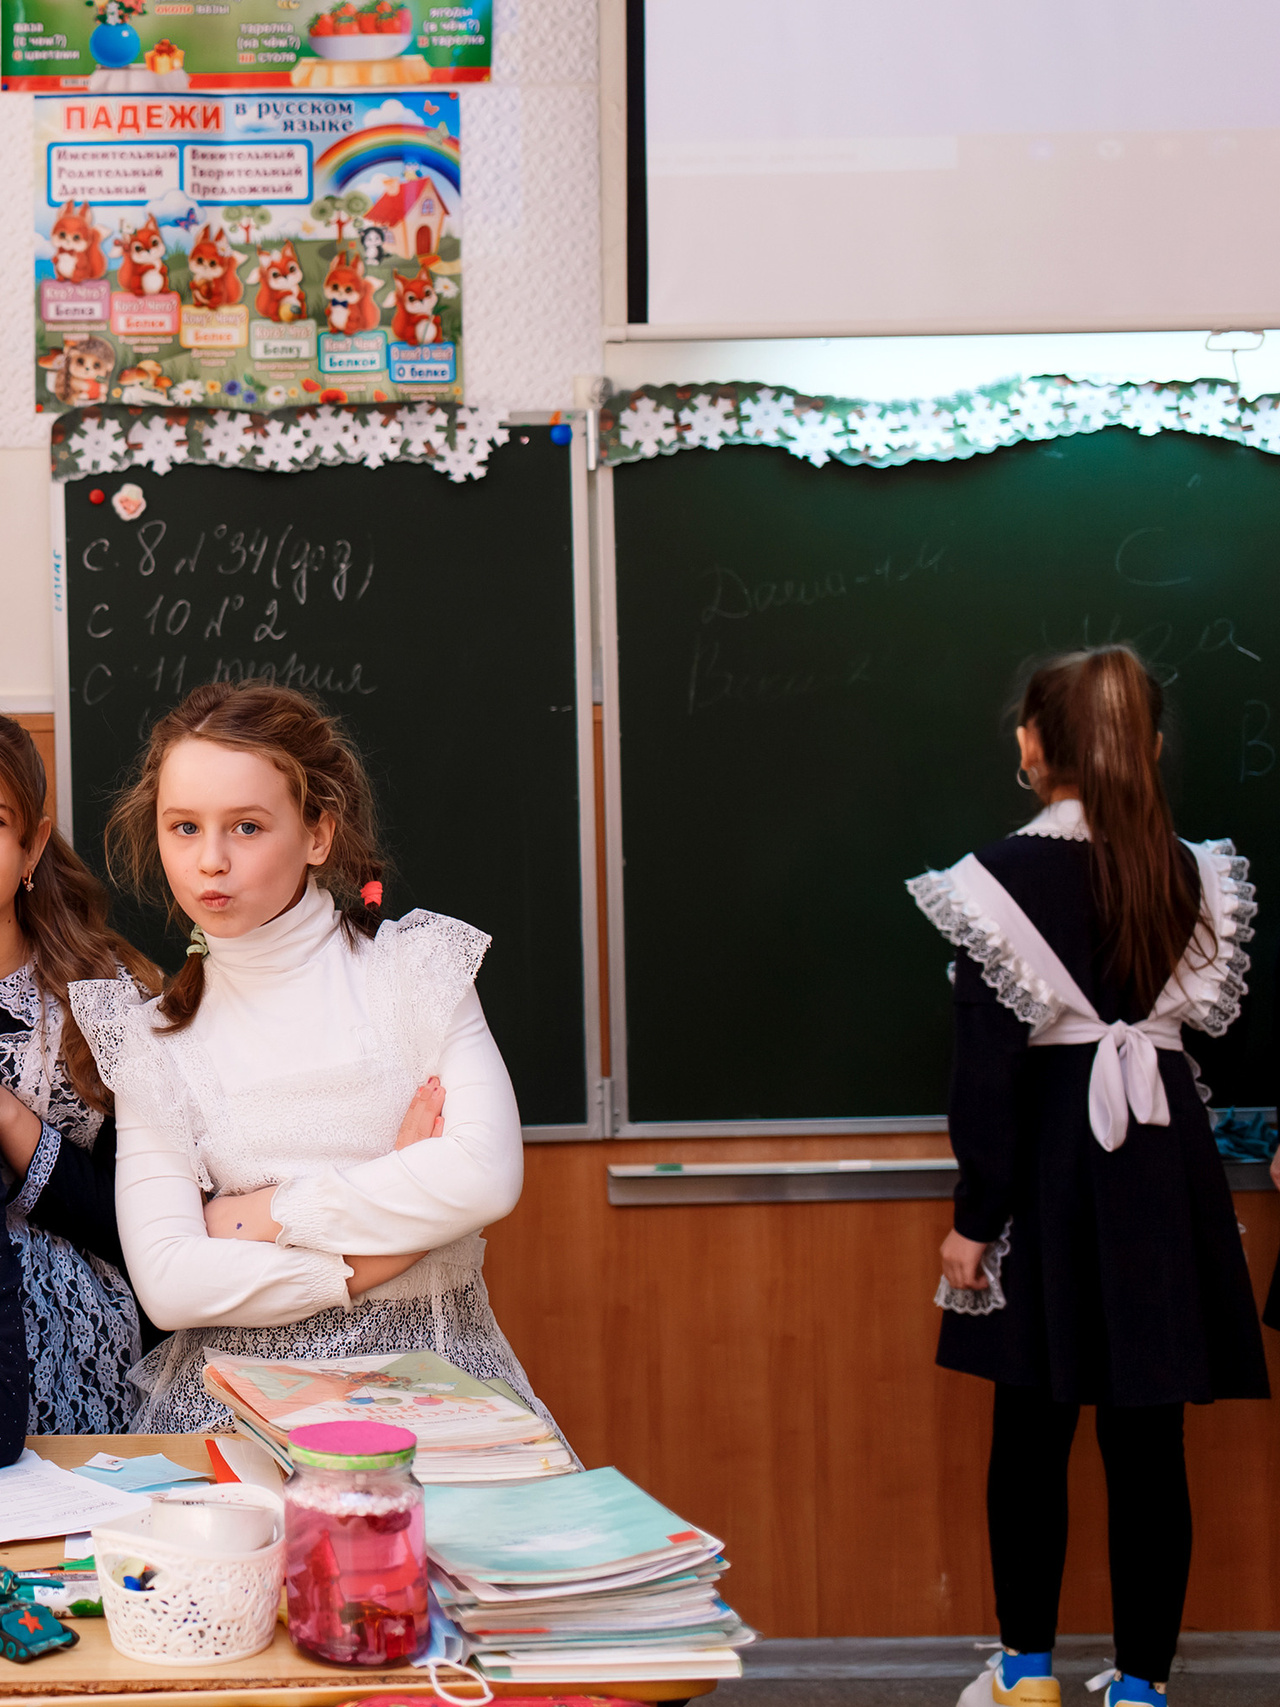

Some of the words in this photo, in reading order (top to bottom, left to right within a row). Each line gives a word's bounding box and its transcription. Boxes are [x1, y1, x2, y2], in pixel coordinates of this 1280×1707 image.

[234, 102, 248, 115] в
[257, 101, 353, 118] русском
[65, 104, 222, 134] ПАДЕЖИ
[282, 119, 355, 133] языке
[56, 148, 179, 161] Именительный
[190, 148, 296, 161] Винительный
[57, 166, 163, 178] Родительный
[190, 166, 303, 178] Творительный
[58, 184, 147, 197] Дательный
[190, 183, 293, 197] Предложный
[55, 305, 95, 316] Белка
[263, 344, 303, 358] Белку
[328, 355, 377, 368] Белкой
[137, 518, 168, 576] 8
[144, 593, 192, 636] 10
[365, 1403, 501, 1421] Русский
